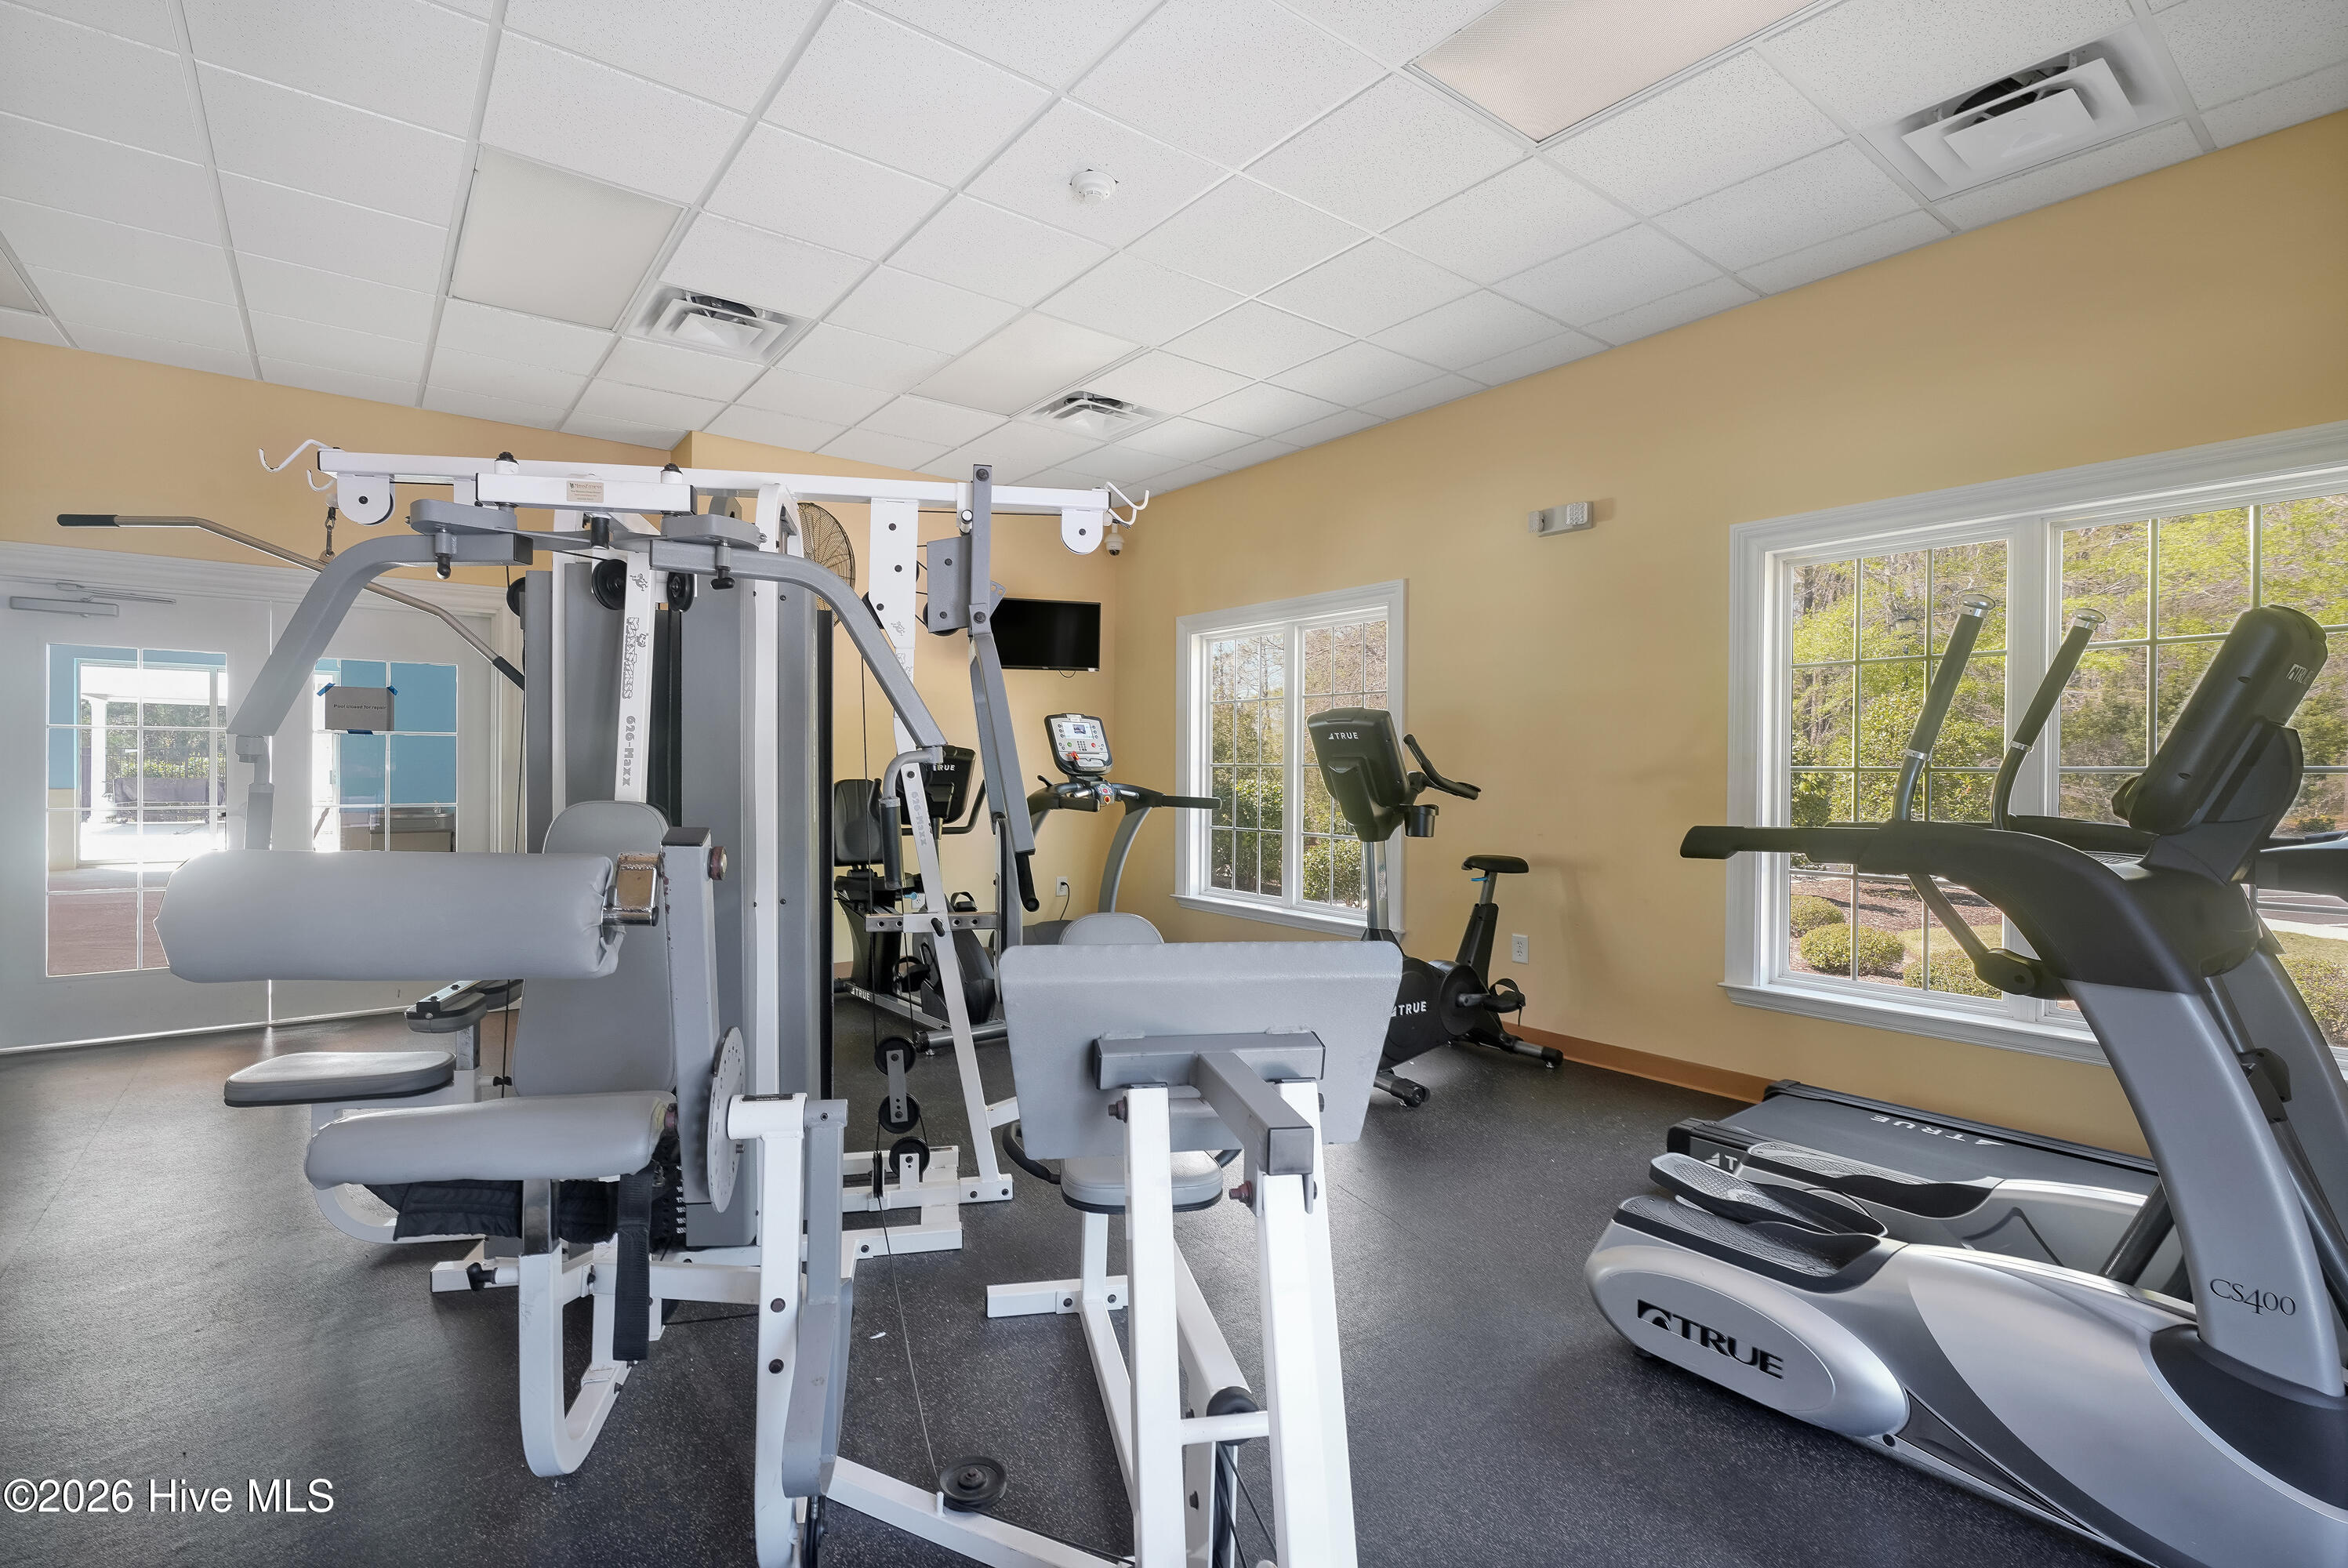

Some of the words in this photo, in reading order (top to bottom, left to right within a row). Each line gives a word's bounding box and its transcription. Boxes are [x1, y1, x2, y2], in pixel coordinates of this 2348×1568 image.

[1334, 731, 1359, 740] TRUE
[622, 715, 637, 787] 626-Maxx
[855, 987, 871, 1002] TRUE
[1398, 1000, 1428, 1016] TRUE
[1869, 1114, 1967, 1142] TRUE
[2209, 1278, 2296, 1316] CS400
[1672, 1313, 1784, 1380] TRUE
